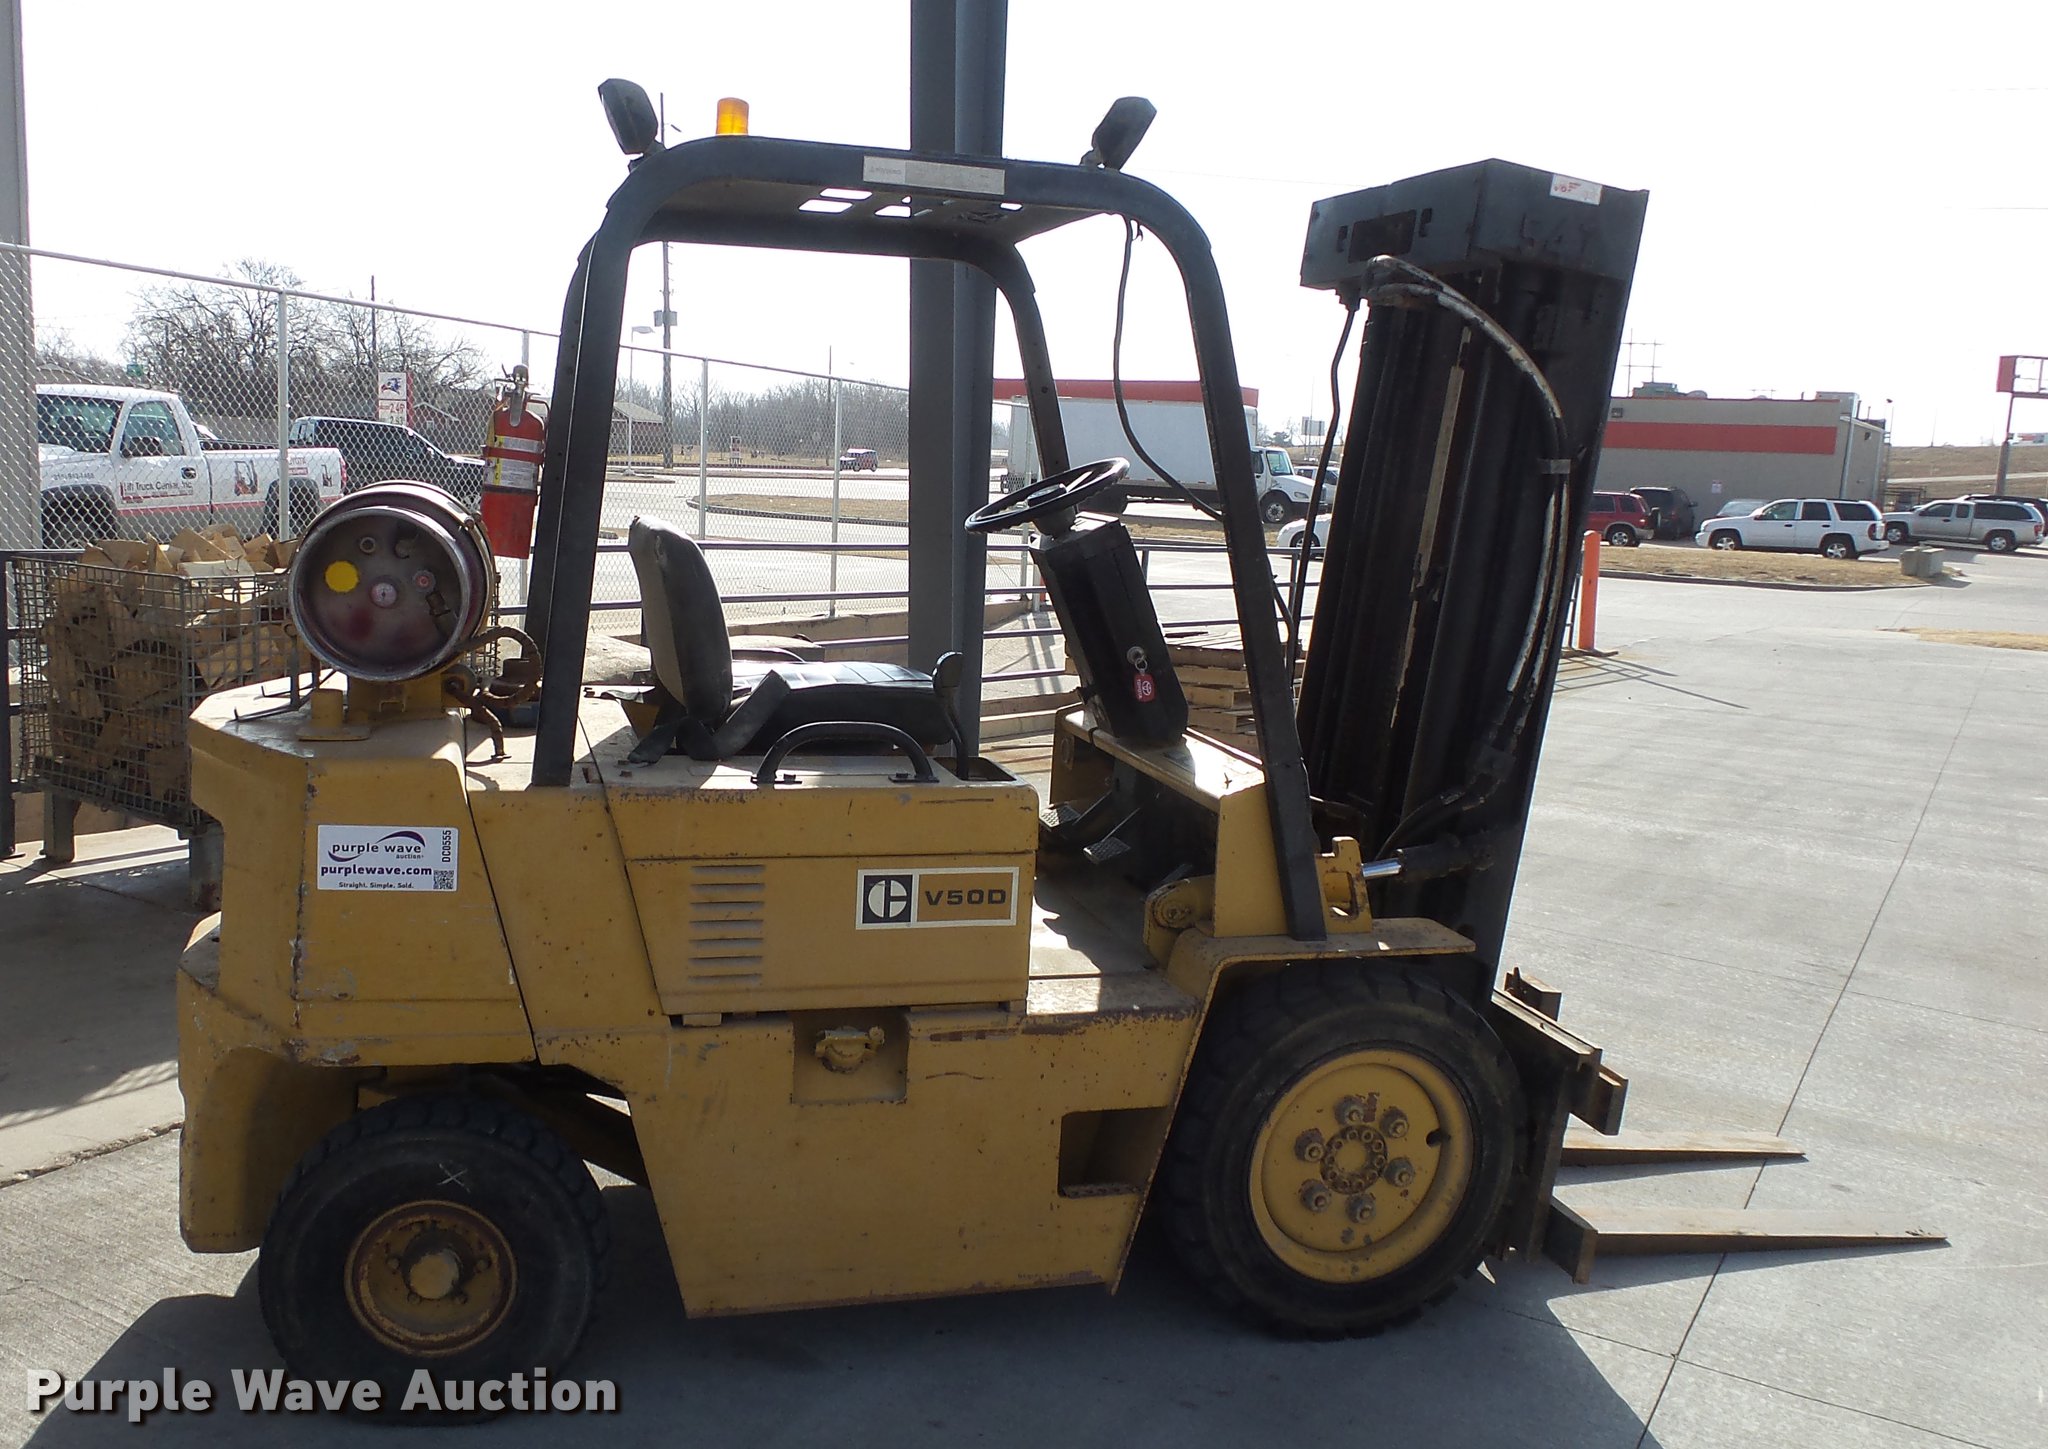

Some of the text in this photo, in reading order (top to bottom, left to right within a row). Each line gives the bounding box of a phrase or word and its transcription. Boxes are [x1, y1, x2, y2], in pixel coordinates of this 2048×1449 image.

[332, 842, 422, 854] purple wave
[321, 864, 432, 877] purplewave.com
[338, 881, 368, 889] Straight.
[369, 881, 396, 890] Simple.
[925, 889, 1007, 906] V50D
